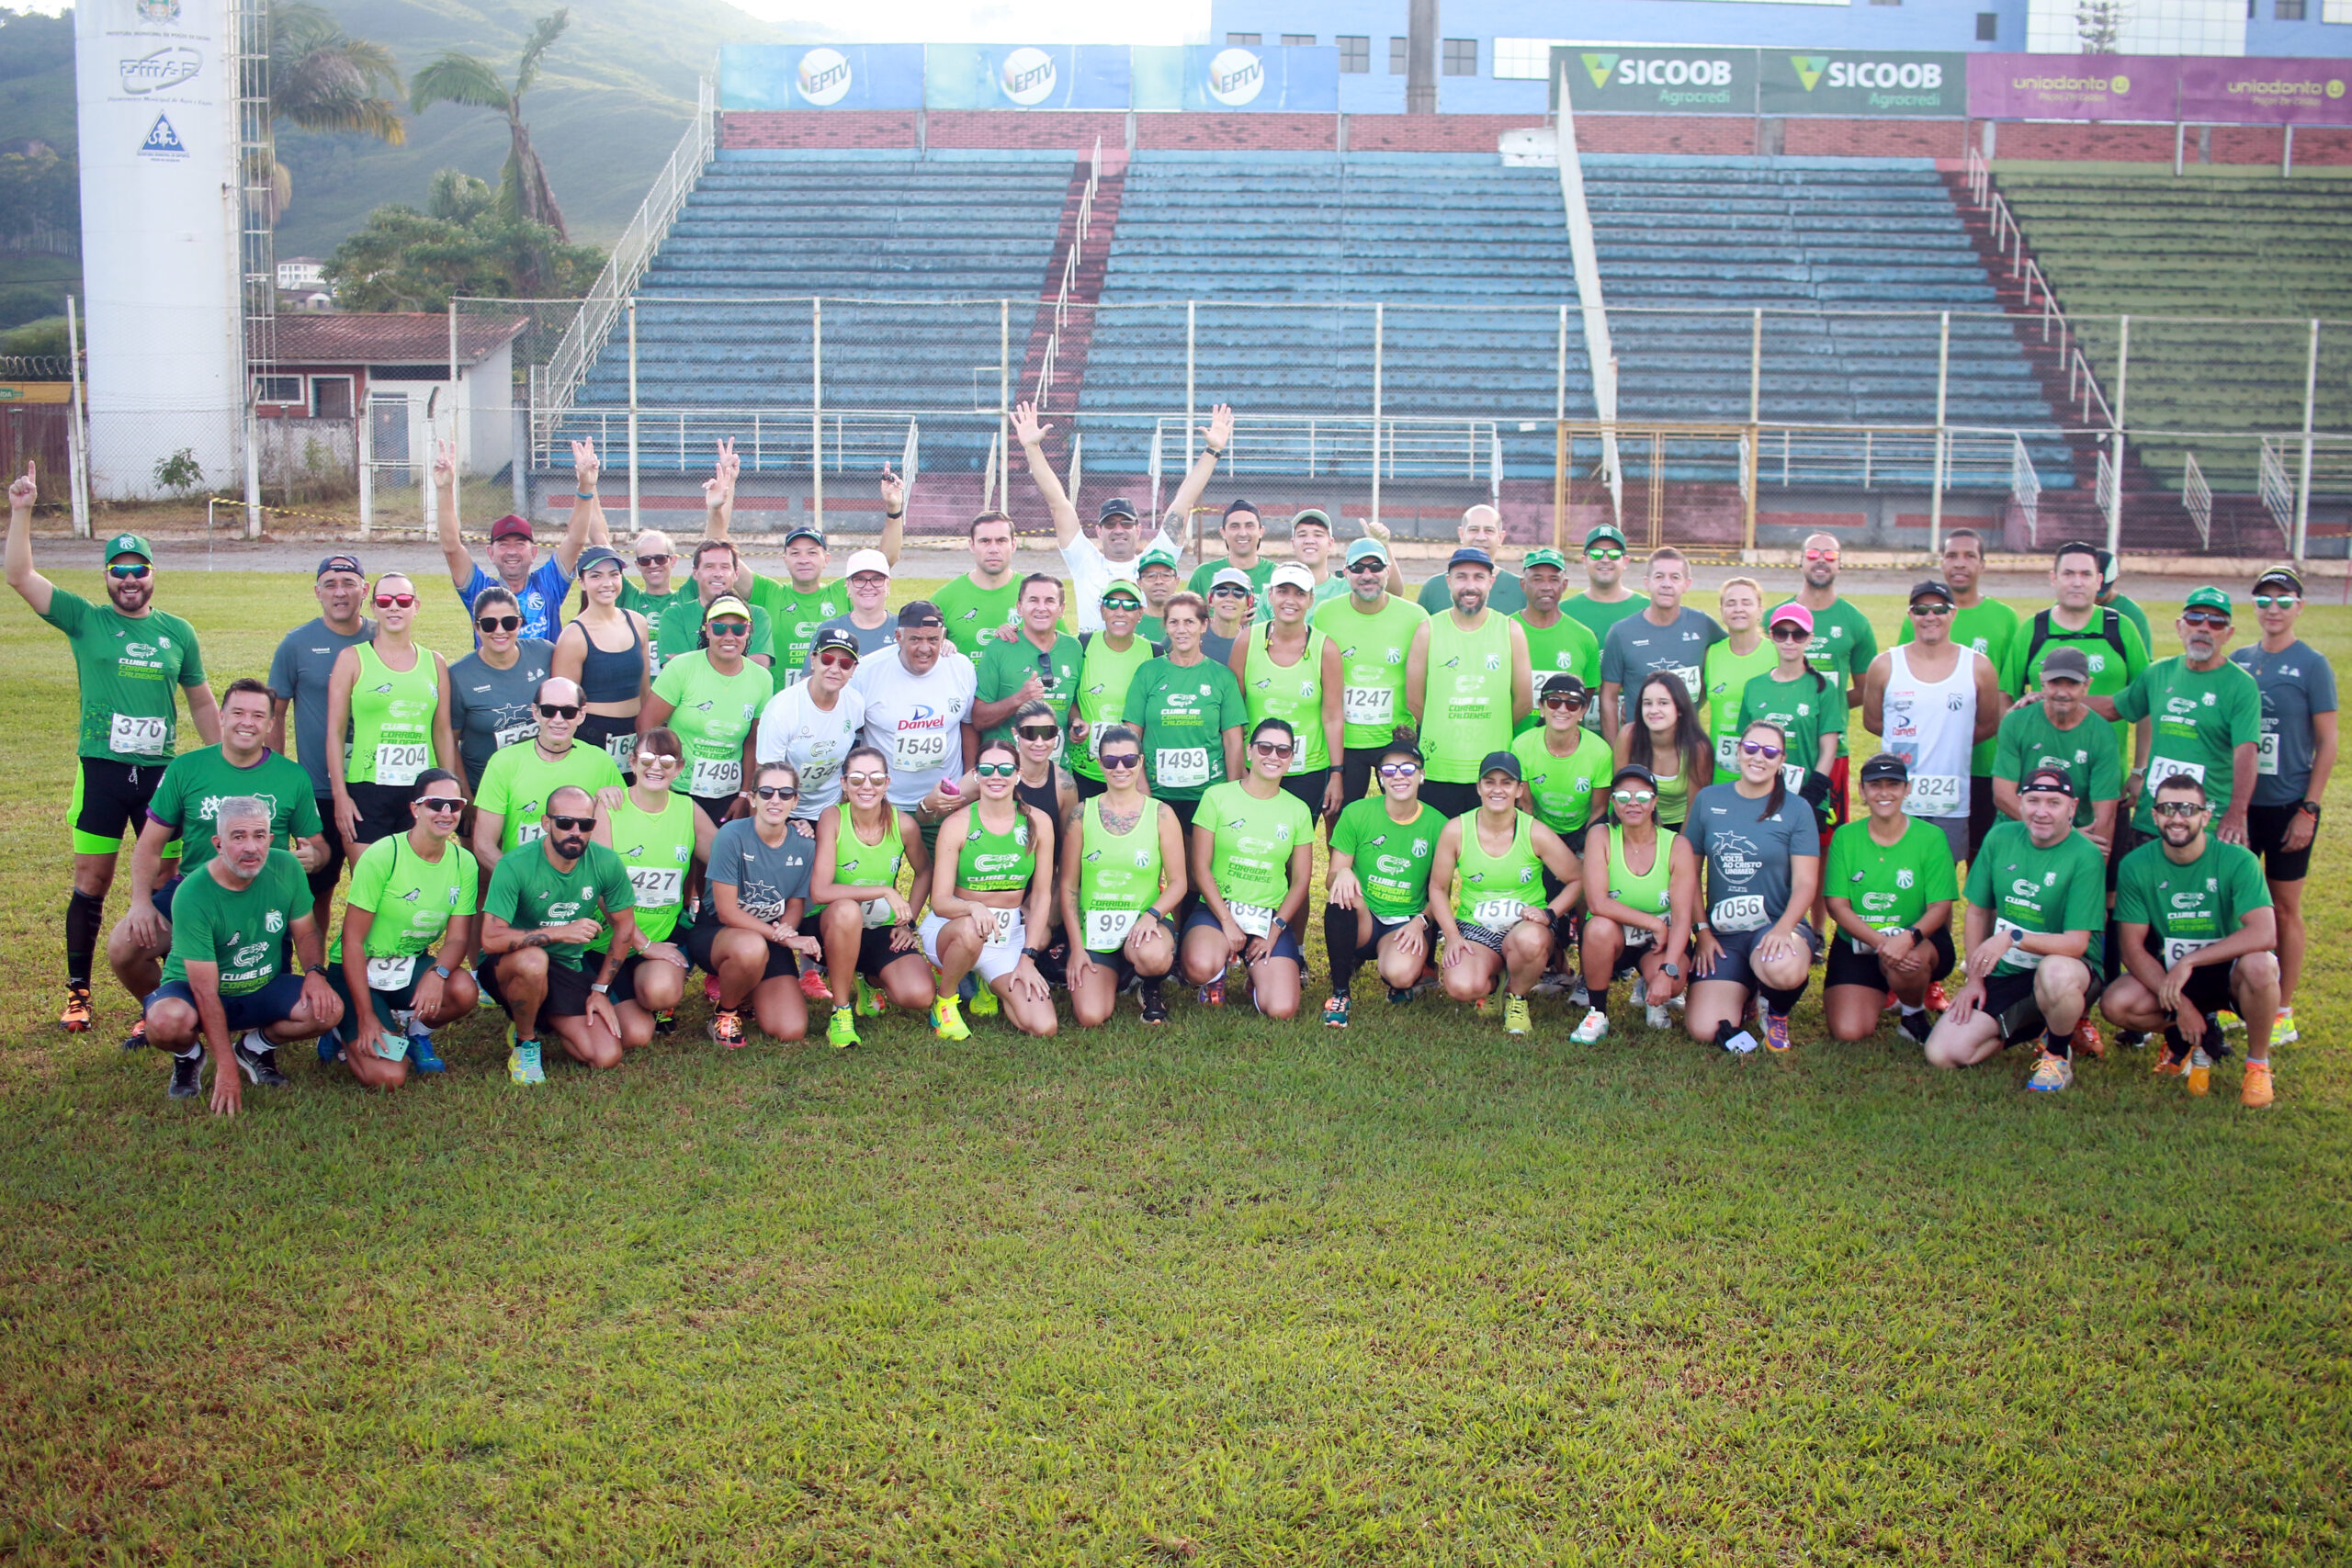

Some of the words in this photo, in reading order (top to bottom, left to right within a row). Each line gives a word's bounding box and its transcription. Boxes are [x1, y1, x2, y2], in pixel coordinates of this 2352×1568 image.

[809, 56, 850, 94] EPTV
[1014, 55, 1056, 94] EPTV
[1222, 56, 1262, 95] EPTV
[1618, 60, 1731, 85] SICOOB
[1827, 62, 1942, 89] SICOOB
[2012, 75, 2109, 91] uniodonto
[2227, 79, 2324, 96] uniodonto
[1658, 89, 1730, 106] Agrocredi
[1869, 92, 1940, 108] Agrocredi
[118, 658, 149, 666] CLUBE
[149, 660, 164, 669] DE
[1346, 689, 1392, 707] 1247
[118, 718, 162, 739] 370
[898, 715, 944, 730] Danvel
[380, 731, 424, 740] CORRIDA
[897, 737, 944, 755] 1549
[379, 747, 426, 766] 1204
[1159, 750, 1204, 769] 1493
[695, 761, 741, 781] 1496
[1227, 869, 1272, 884] CALDENSE
[1228, 862, 1268, 875] CORRIDA
[632, 871, 677, 890] 427
[1367, 874, 1397, 889] CLUBE
[1091, 899, 1131, 908] CORRIDA
[1714, 898, 1760, 920] 1056
[1100, 914, 1126, 932] 99
[2167, 911, 2196, 919] CLUBE
[220, 970, 258, 982] CLUBE
[259, 964, 273, 976] DE
